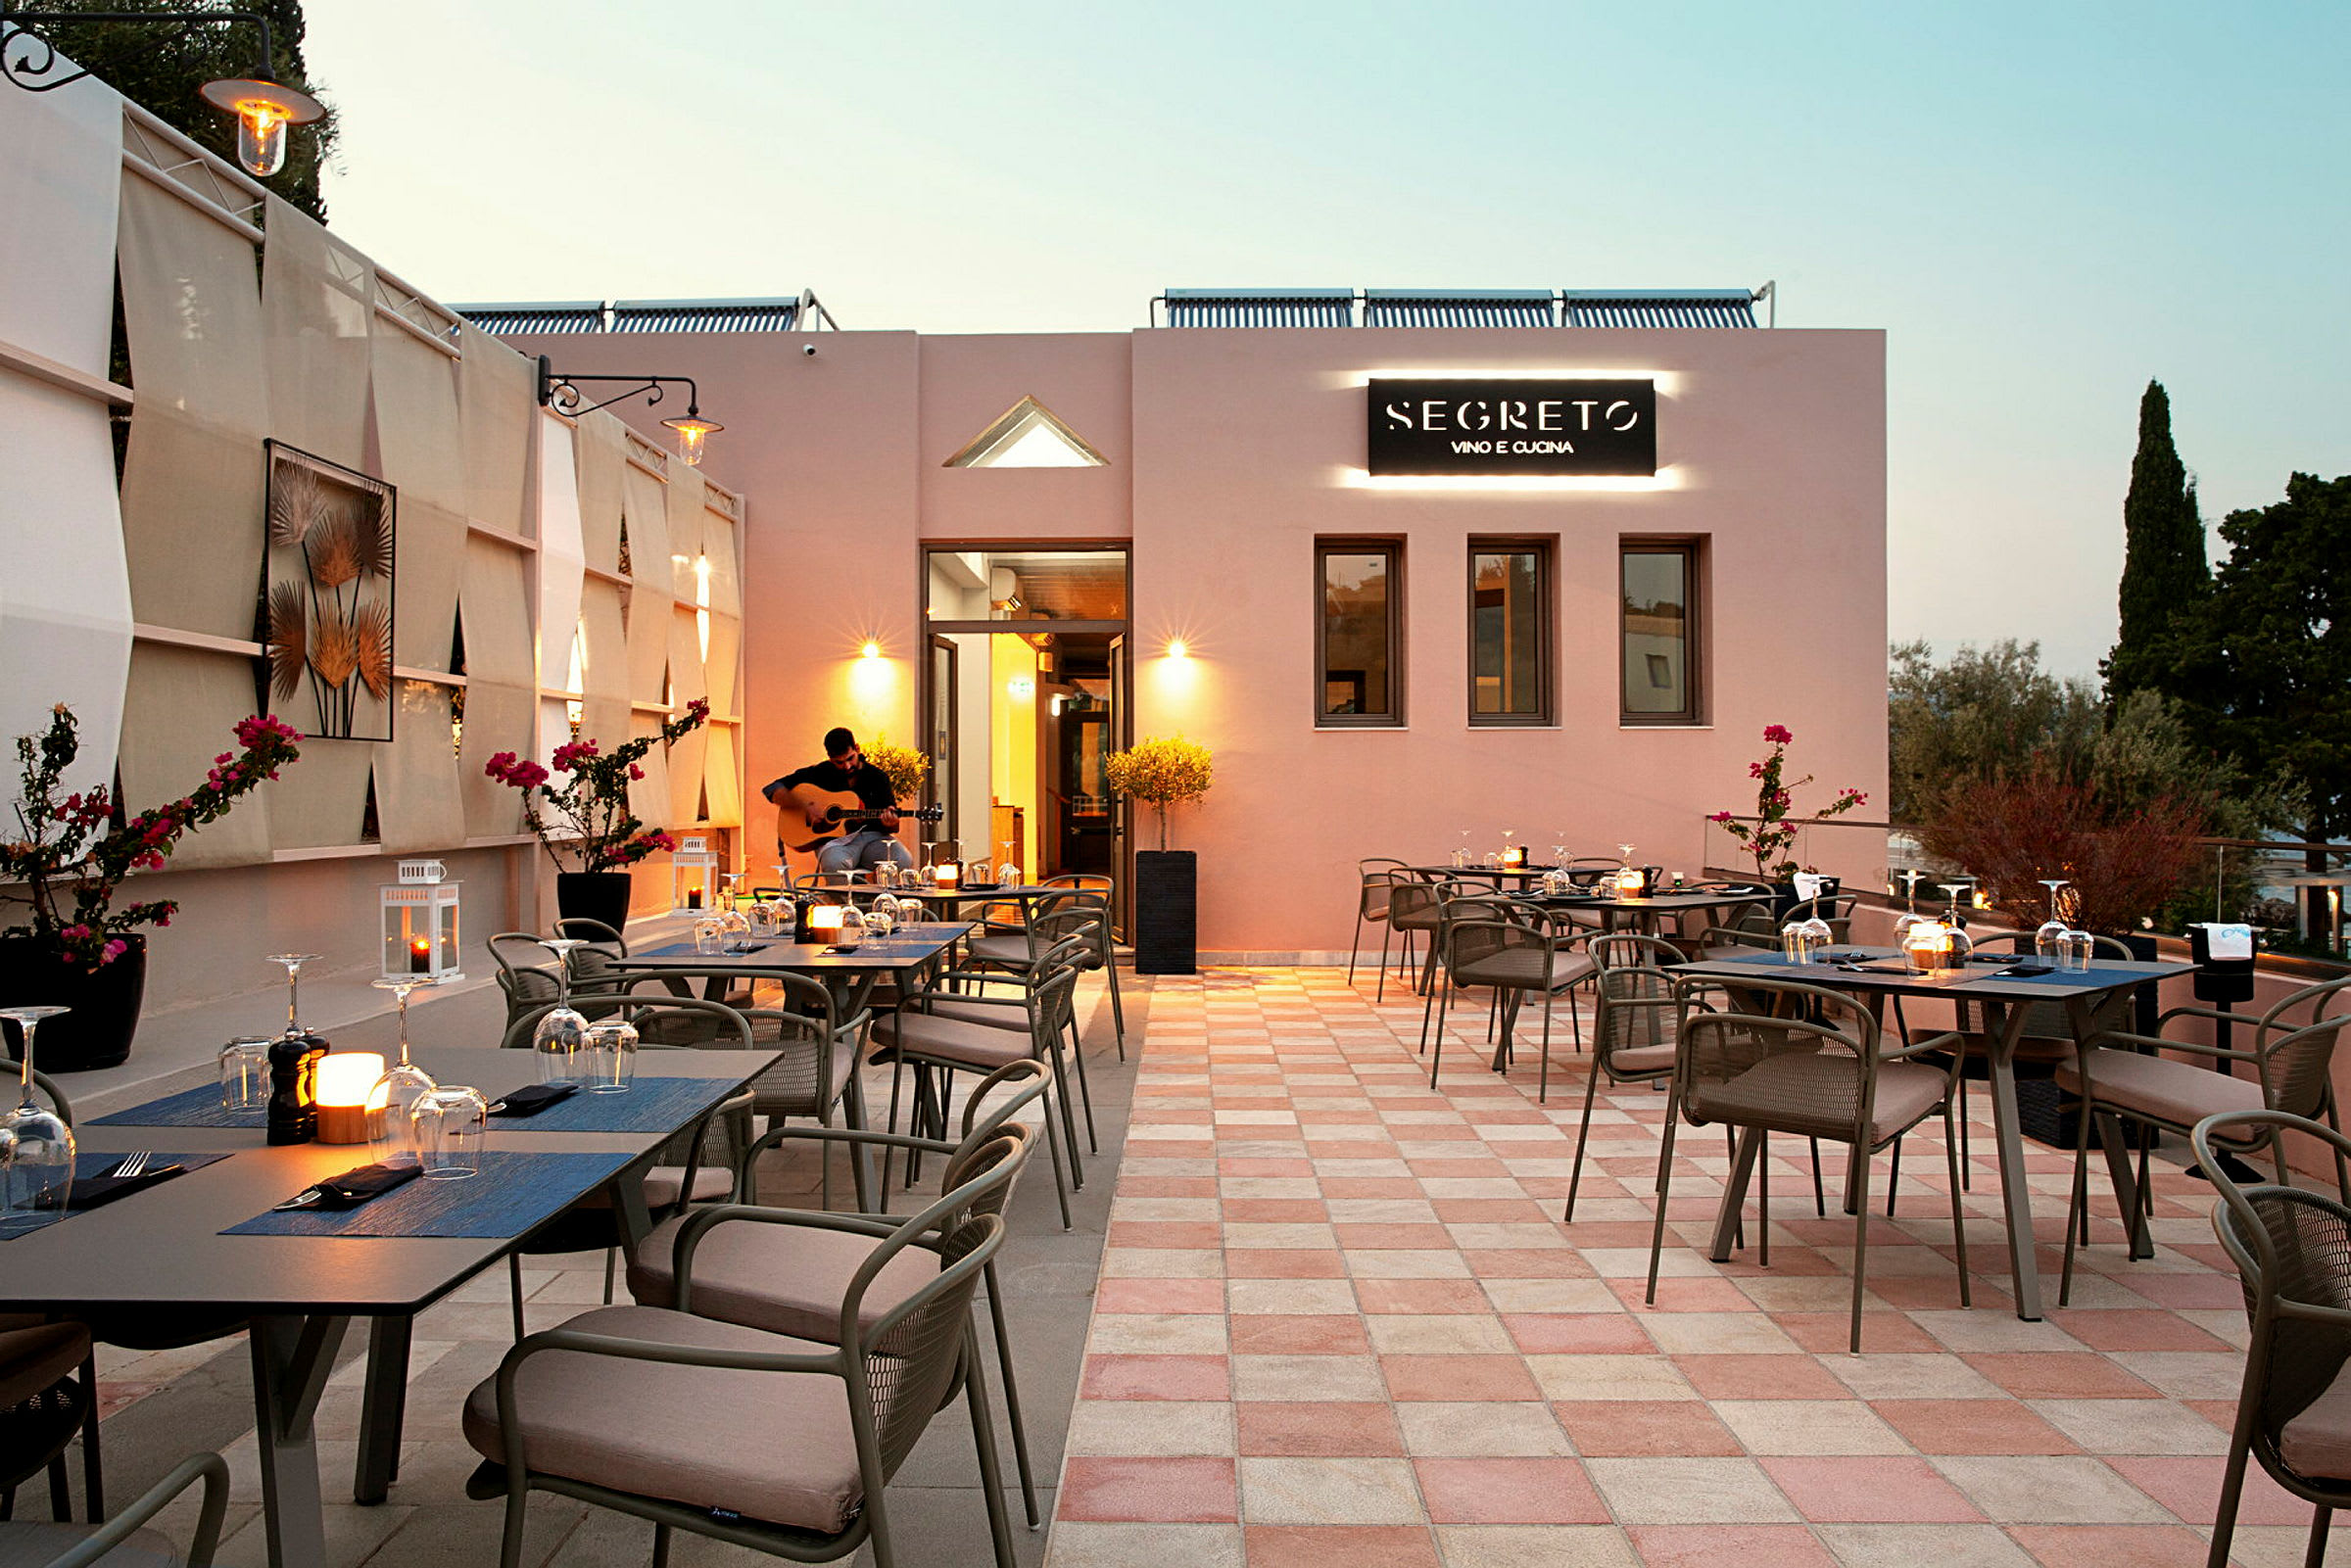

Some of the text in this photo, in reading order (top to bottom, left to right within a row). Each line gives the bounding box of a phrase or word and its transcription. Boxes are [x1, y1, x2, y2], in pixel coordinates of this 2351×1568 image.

[1385, 400, 1638, 431] SEGRETO
[1451, 440, 1574, 454] VINO E CUCINA
